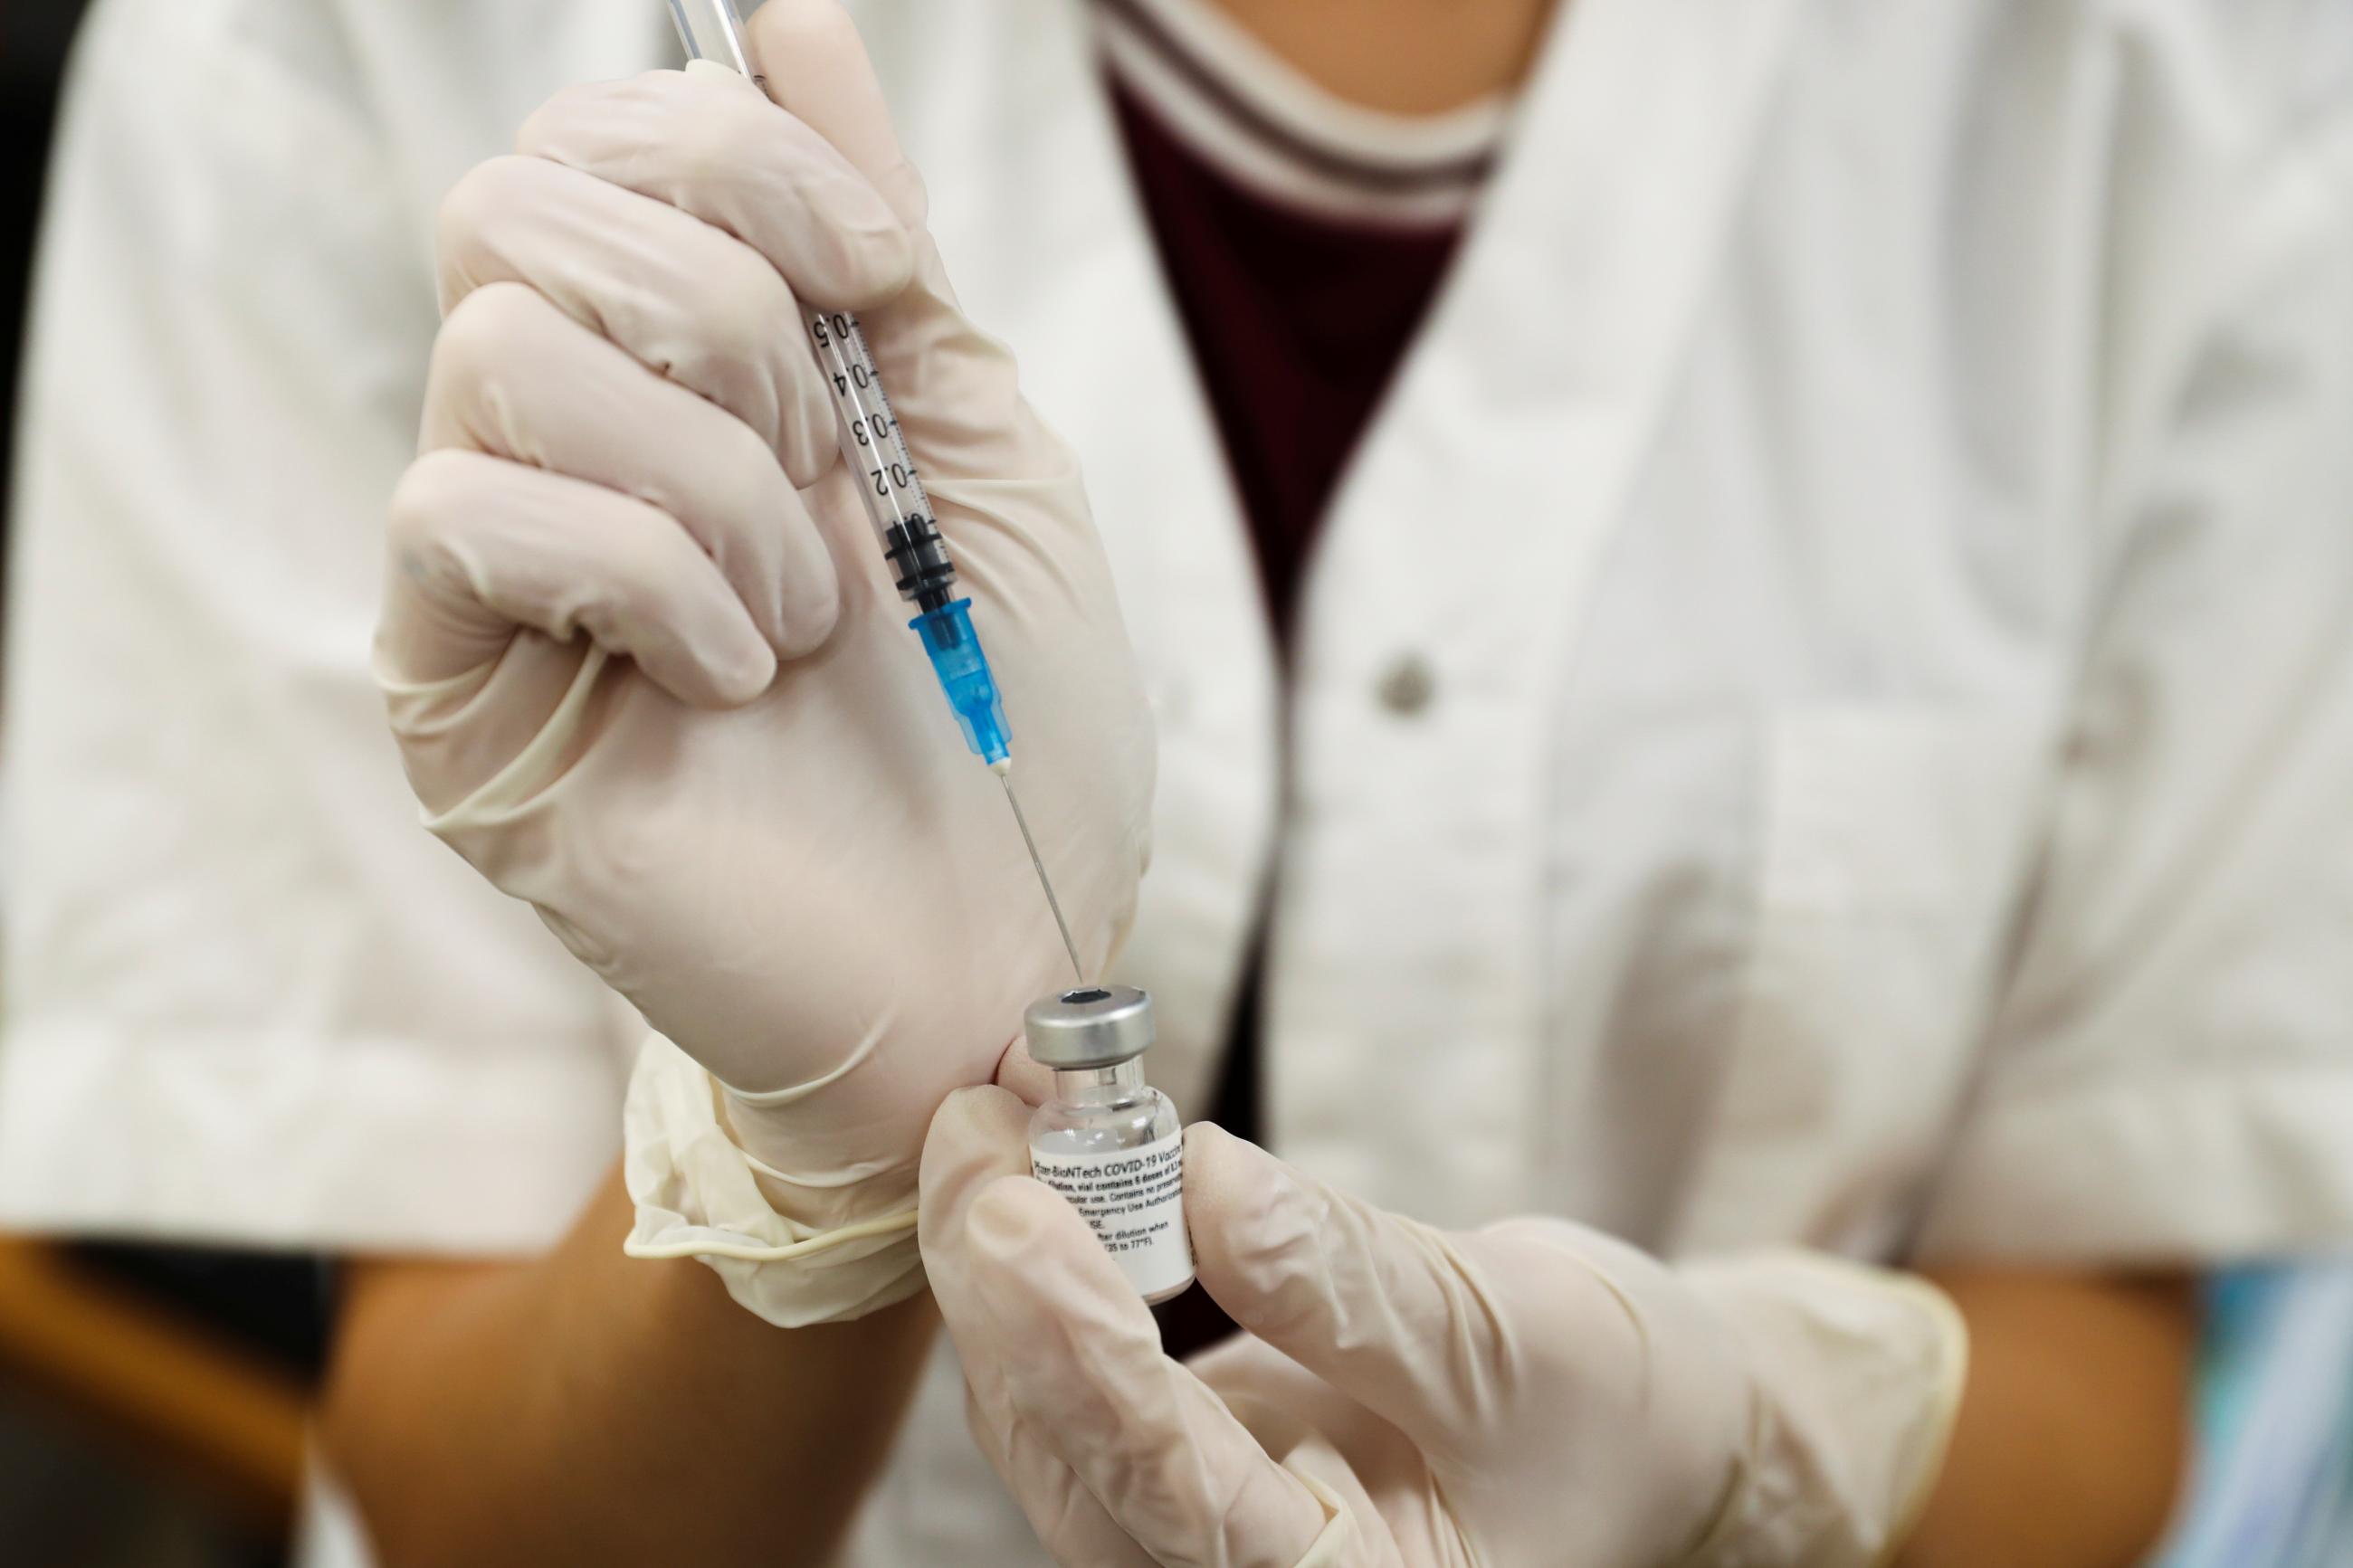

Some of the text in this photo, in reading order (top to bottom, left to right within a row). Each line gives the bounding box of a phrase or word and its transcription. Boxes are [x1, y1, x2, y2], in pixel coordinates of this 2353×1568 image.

[814, 314, 849, 347] 0.5
[834, 364, 869, 396] 0.4
[853, 413, 888, 446] 0.3
[871, 463, 908, 496] 0.2
[1104, 1154, 1157, 1176] COVID-19
[1078, 1182, 1093, 1192] vial
[1096, 1177, 1133, 1191] contains
[1142, 1170, 1163, 1183] doses
[1110, 1187, 1144, 1202] Contains
[1146, 1185, 1156, 1194] no
[1128, 1202, 1143, 1212] Use
[1115, 1228, 1147, 1240] dilution
[1148, 1221, 1169, 1233] when
